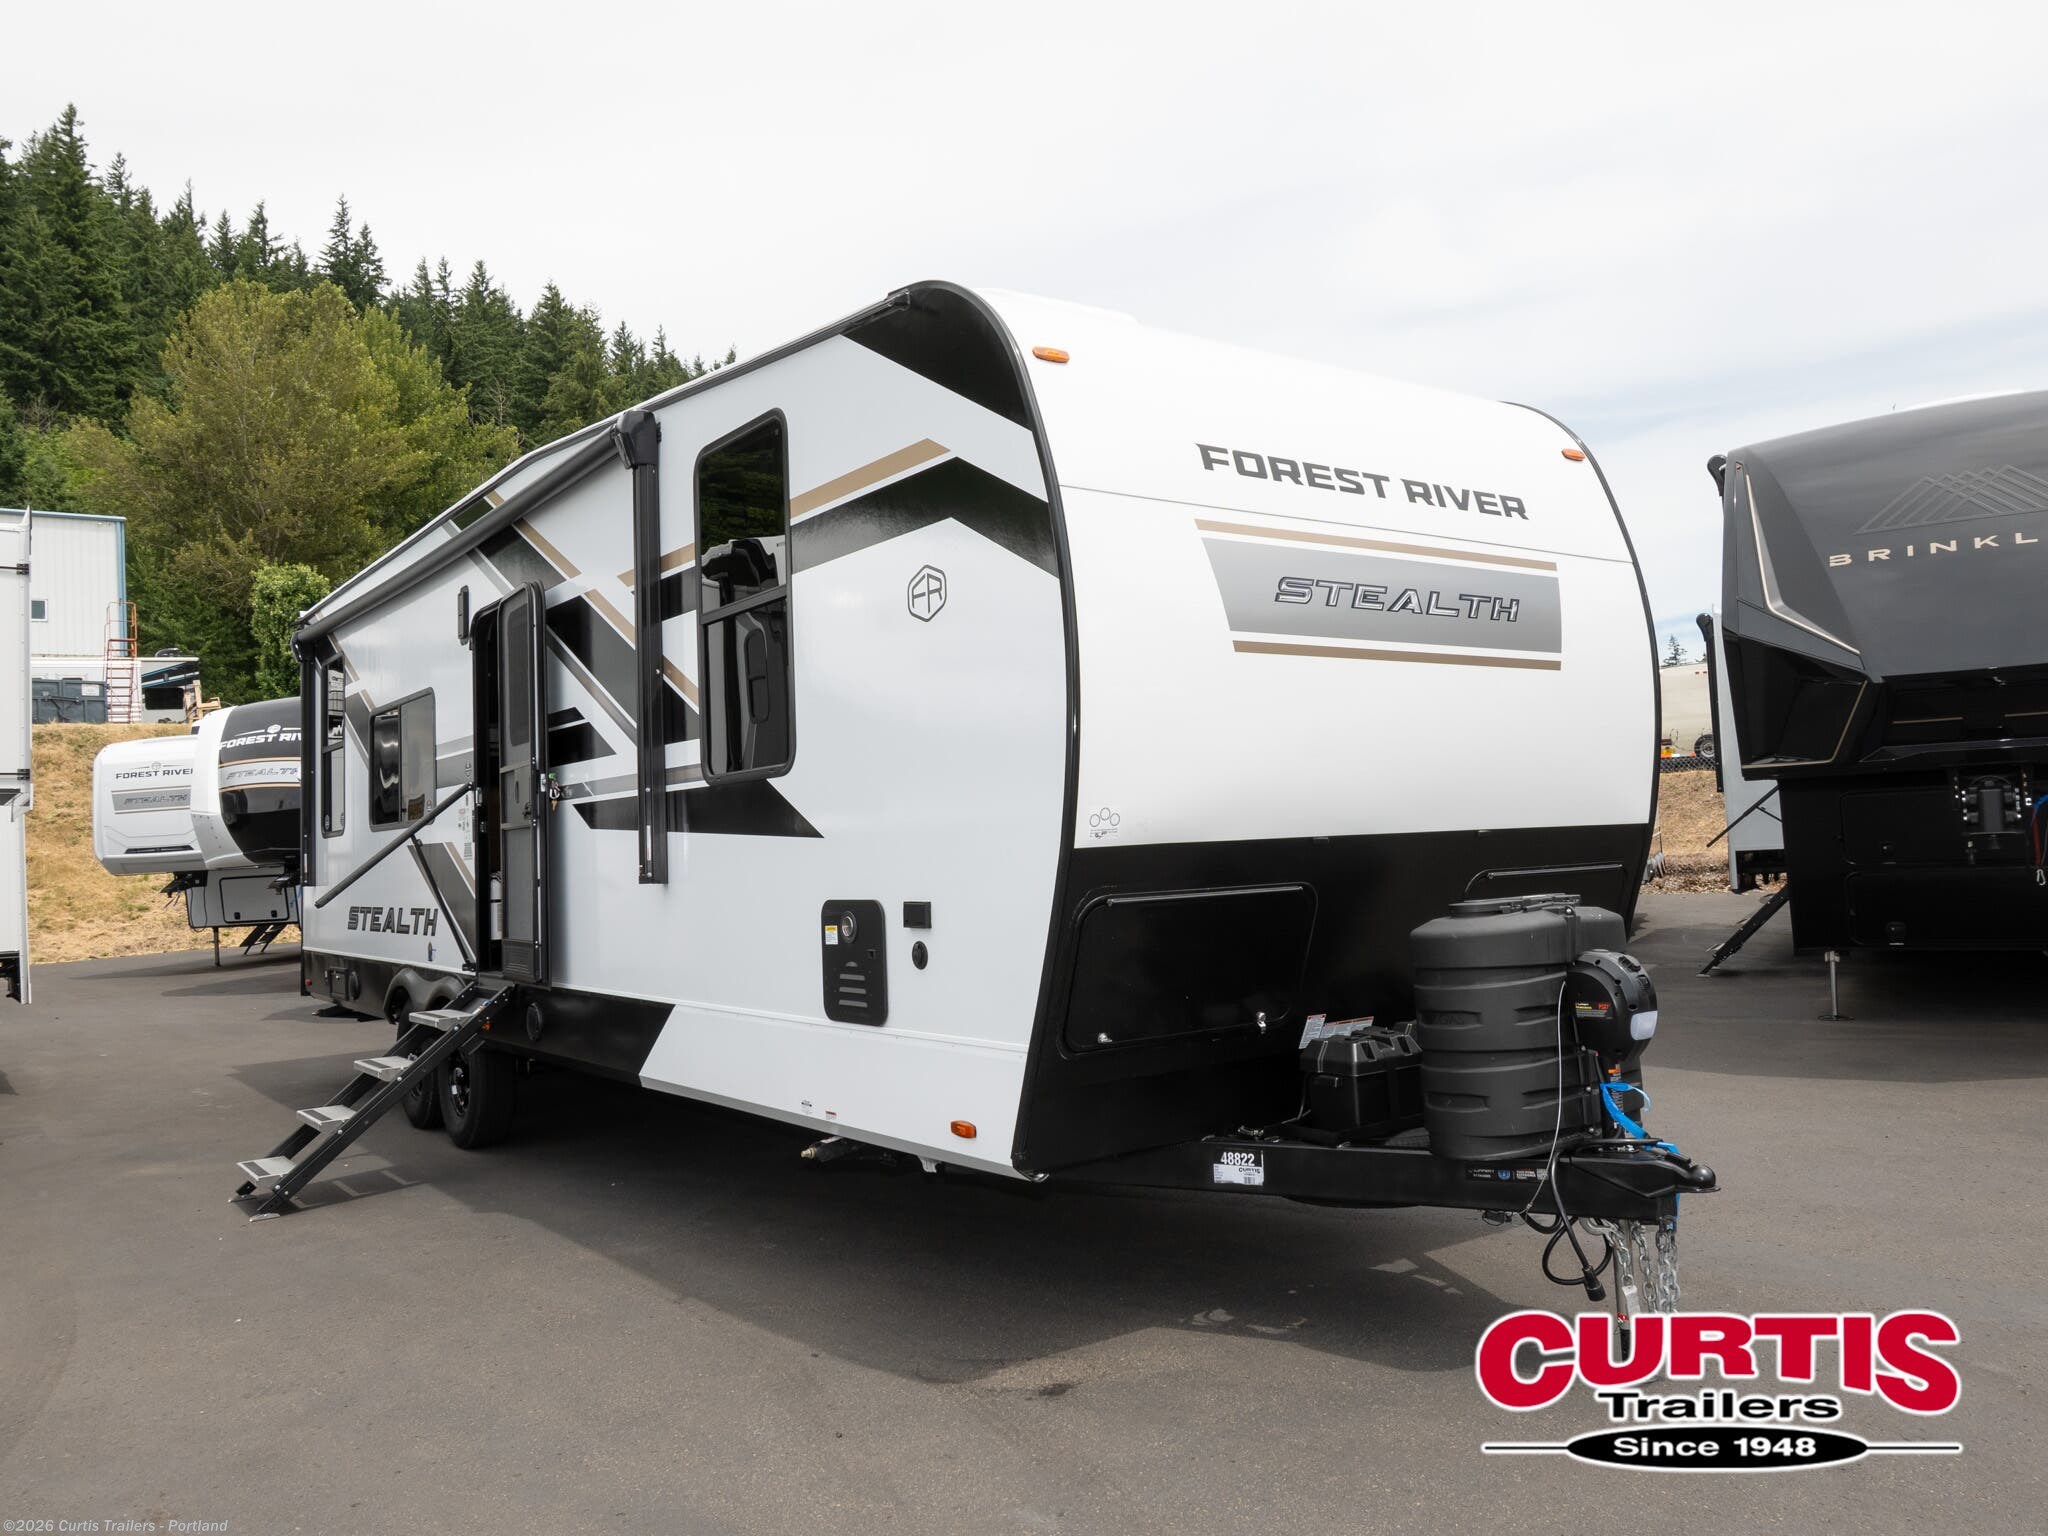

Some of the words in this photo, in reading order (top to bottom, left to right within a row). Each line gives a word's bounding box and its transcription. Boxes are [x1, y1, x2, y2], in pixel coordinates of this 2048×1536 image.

[1195, 443, 1390, 499] FOREST
[1400, 478, 1529, 520] RIVER
[1829, 532, 2039, 568] BRINKL
[1274, 576, 1520, 622] STEALTH
[219, 732, 277, 750] FOREST
[115, 770, 160, 780] FOREST
[347, 906, 439, 937] STEALTH
[1220, 1151, 1255, 1167] 48822
